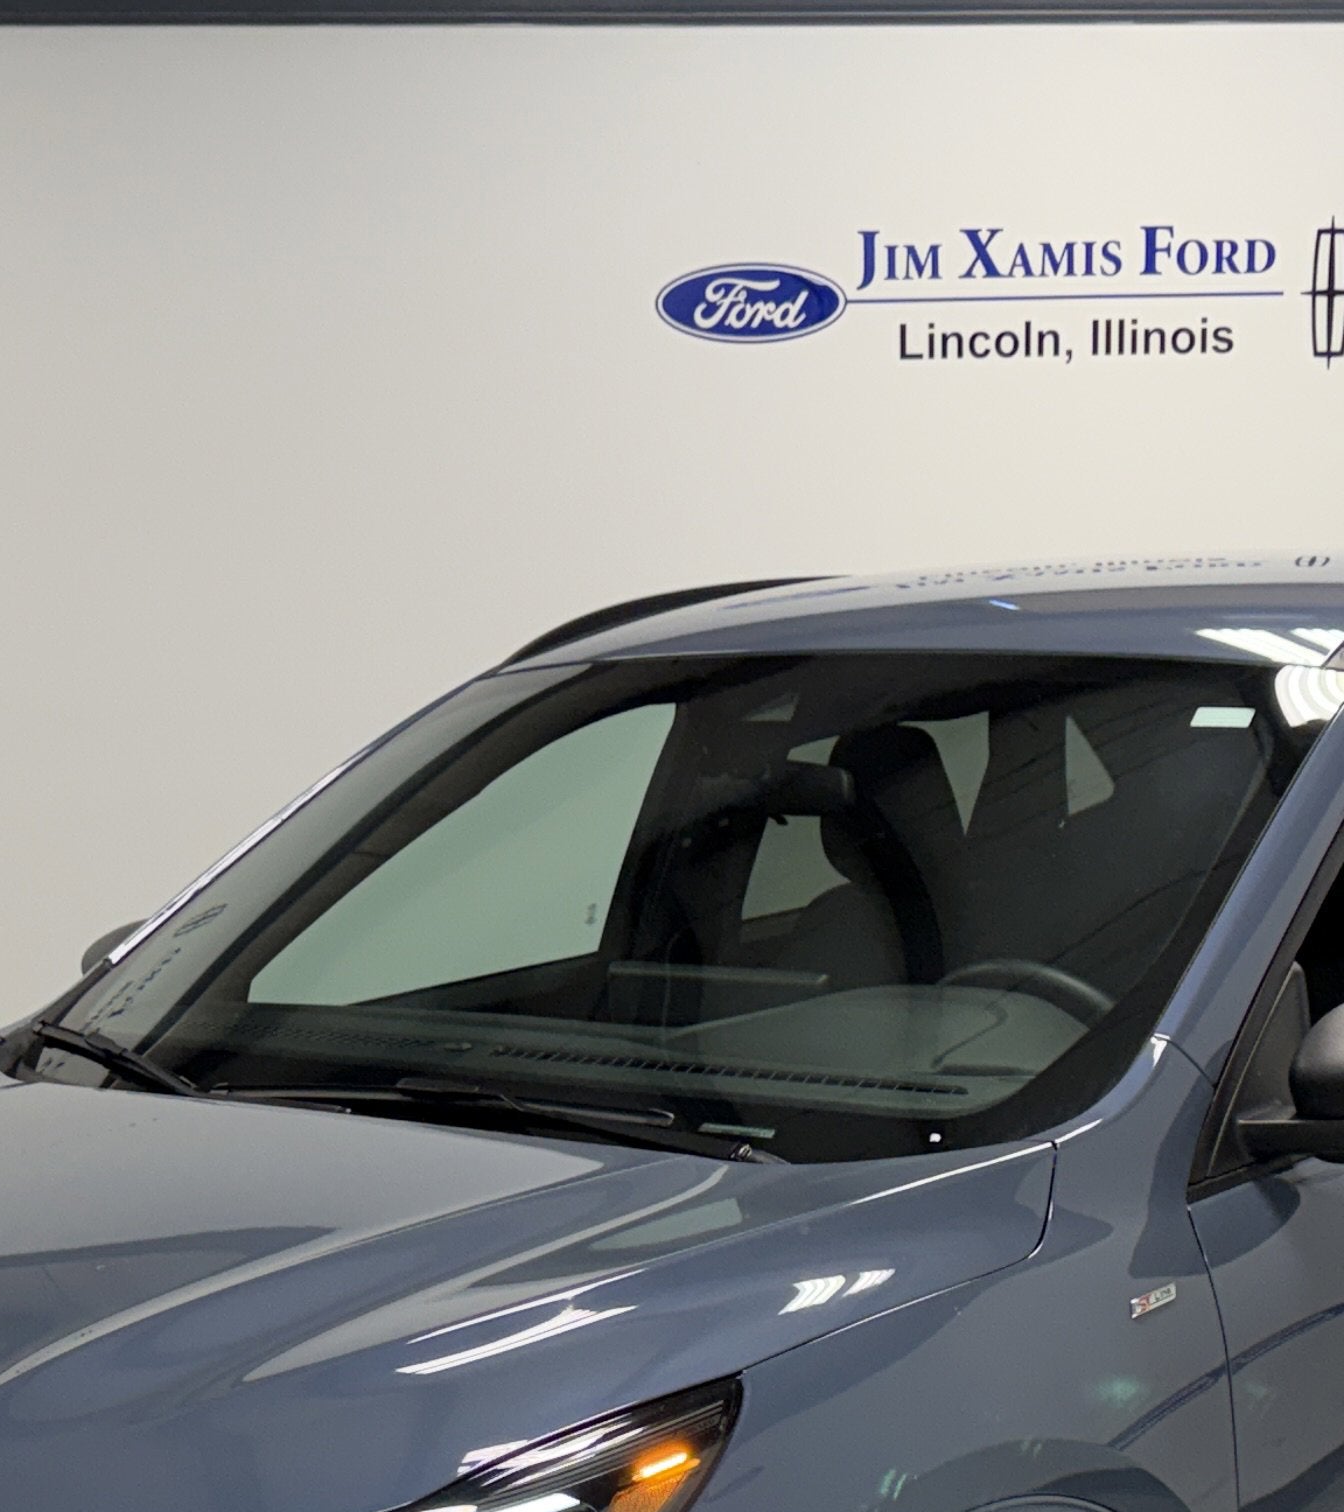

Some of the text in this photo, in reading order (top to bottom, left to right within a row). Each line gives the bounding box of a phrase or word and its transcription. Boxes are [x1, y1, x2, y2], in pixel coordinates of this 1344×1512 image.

[856, 226, 1277, 291] JIM XAMIS FORD
[692, 276, 808, 331] Ford
[899, 318, 1234, 363] Lincoln, Illinois
